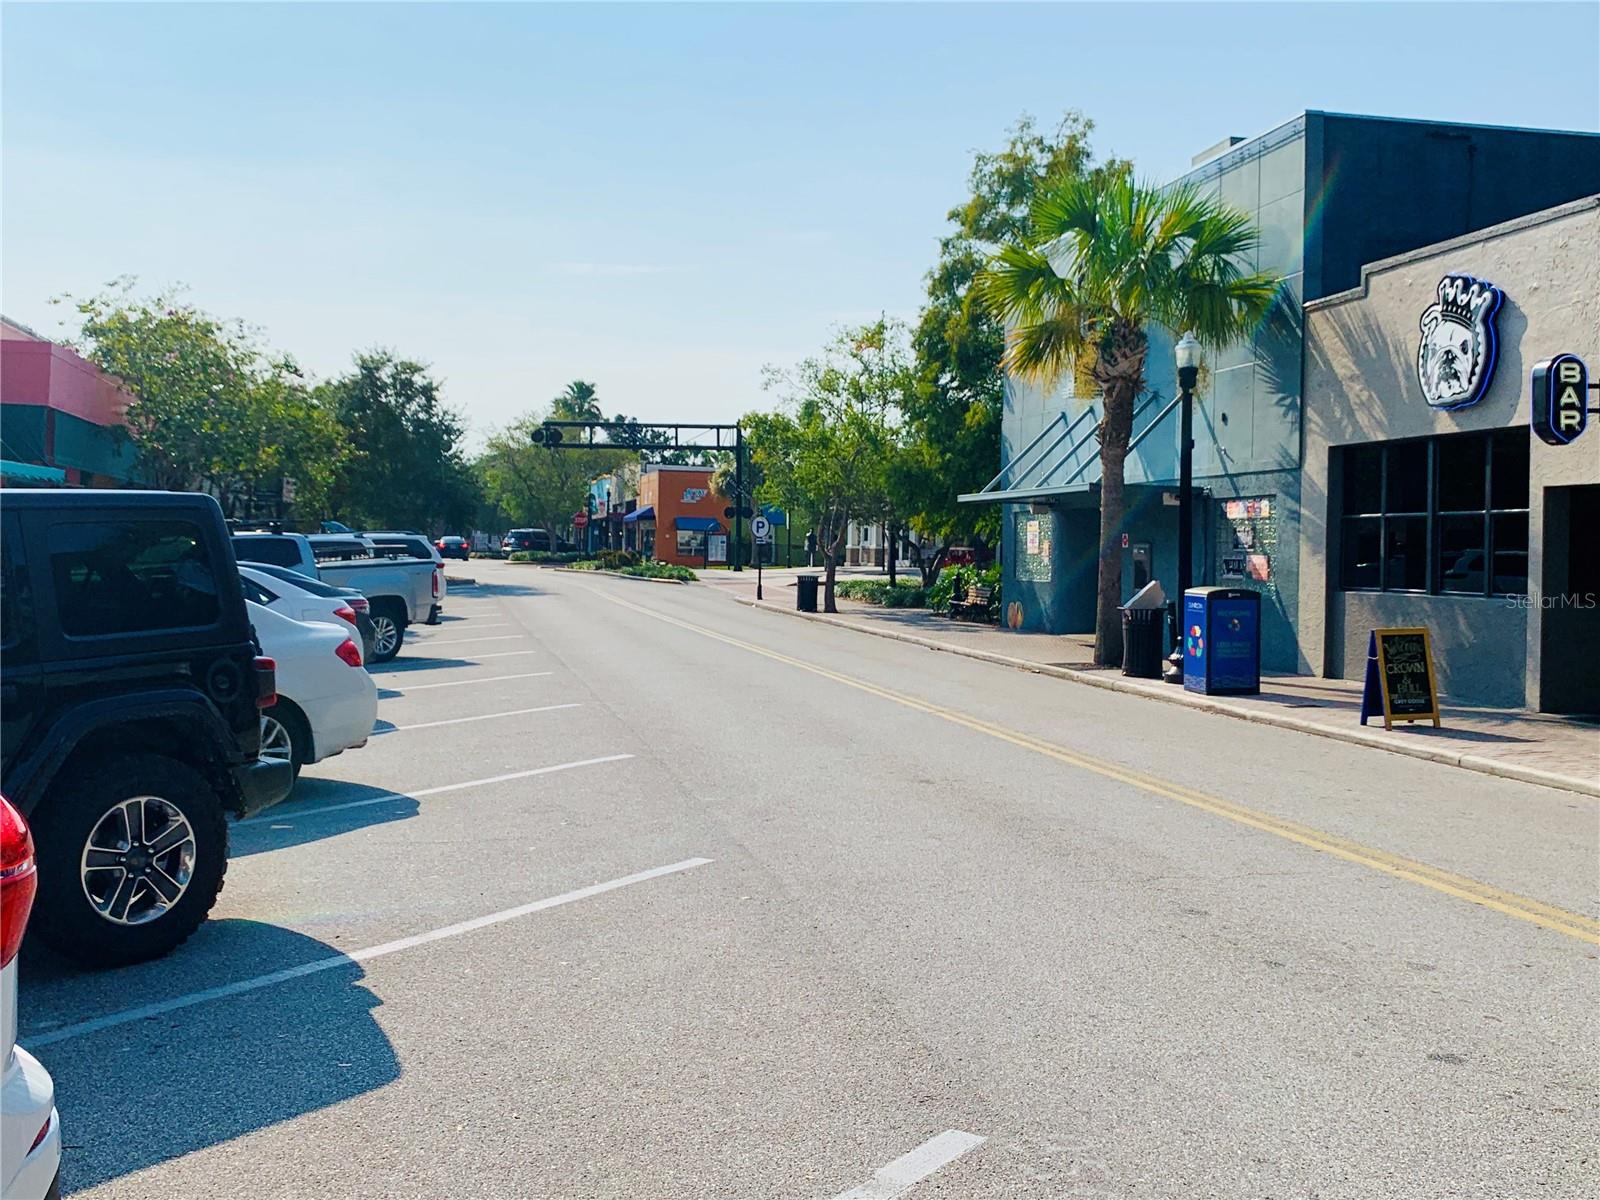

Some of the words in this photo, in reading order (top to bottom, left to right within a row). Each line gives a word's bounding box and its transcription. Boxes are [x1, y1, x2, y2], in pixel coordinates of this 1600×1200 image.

[1560, 363, 1581, 431] BAR
[756, 521, 765, 533] P
[1386, 661, 1425, 674] CROWN
